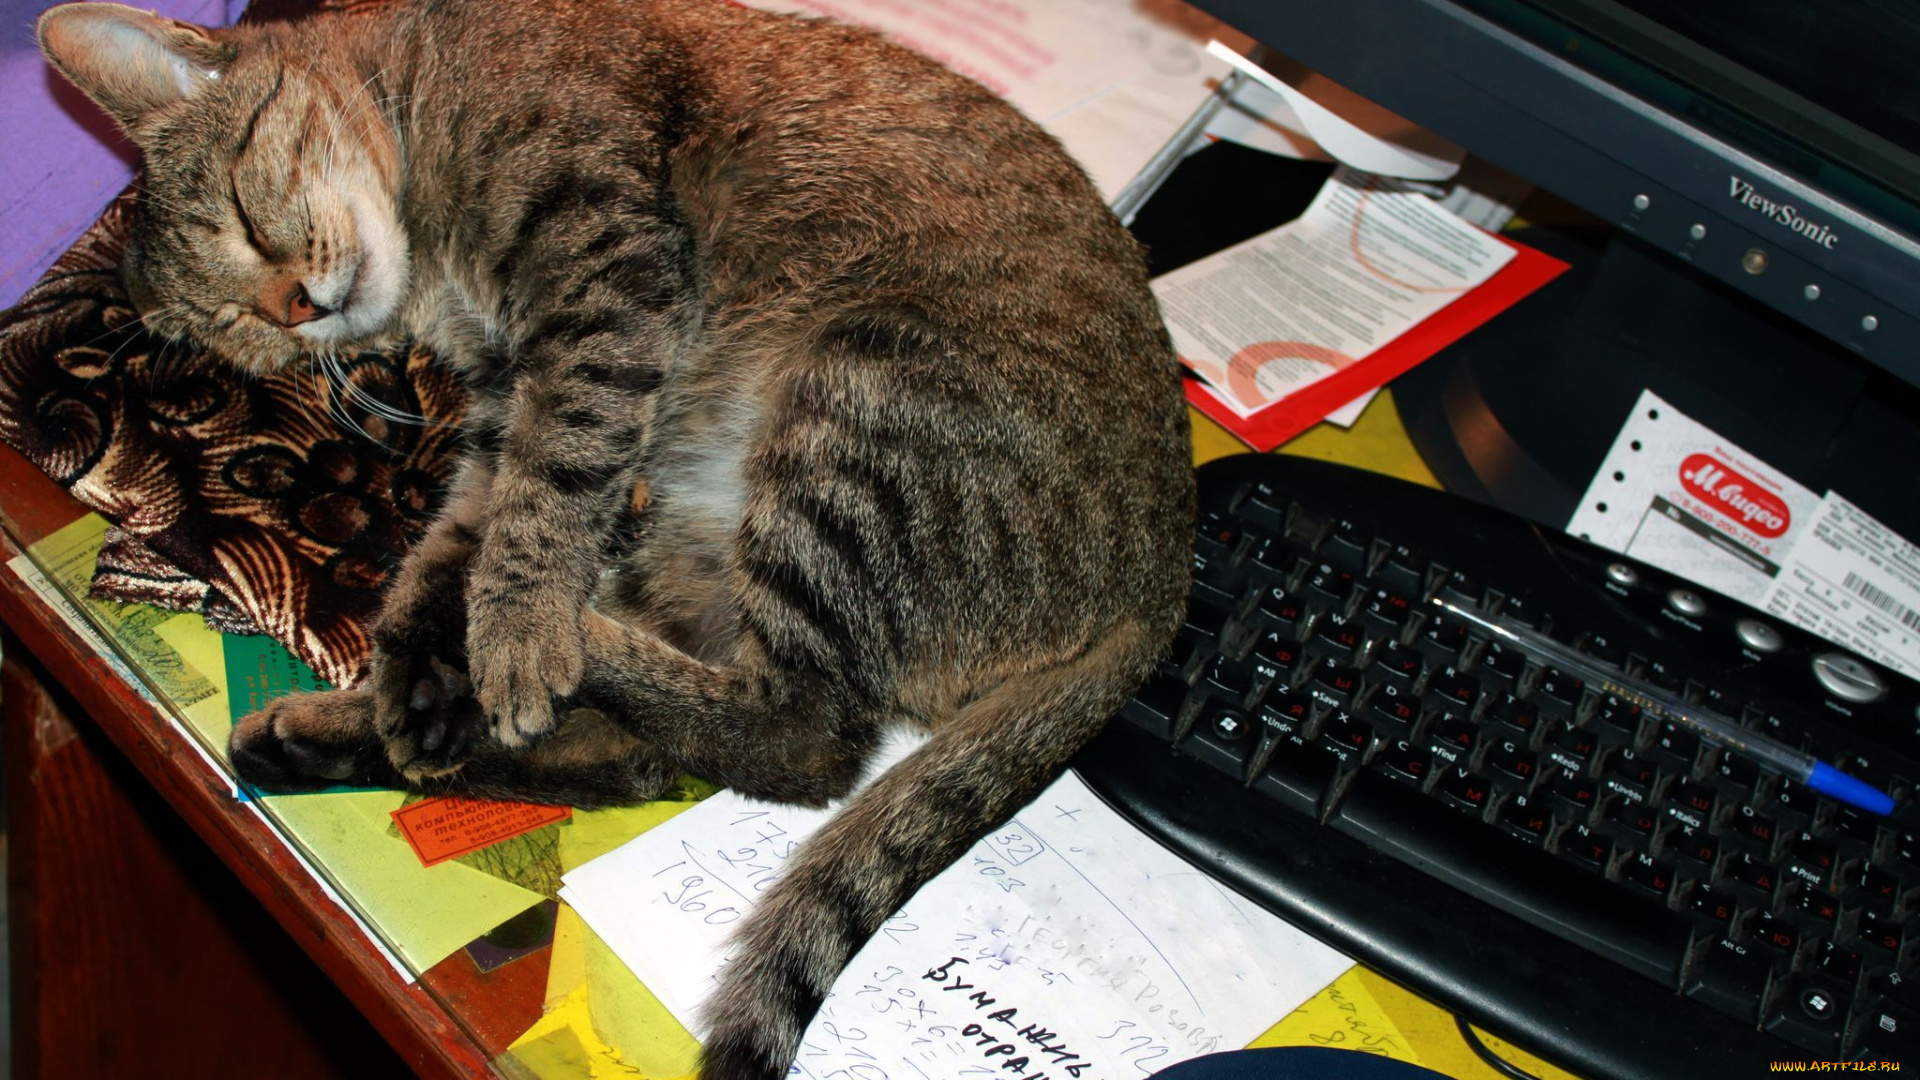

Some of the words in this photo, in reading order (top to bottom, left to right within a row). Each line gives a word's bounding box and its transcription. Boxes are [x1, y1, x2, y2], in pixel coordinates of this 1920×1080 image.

[1729, 176, 1838, 249] ViewSonic
[1319, 692, 1340, 707] Save
[1437, 747, 1458, 762] Find
[1557, 753, 1581, 771] Redo
[996, 834, 1034, 863] 32
[1798, 867, 1822, 885] Print
[1721, 938, 1733, 950] Alt
[1735, 945, 1748, 956] Gr
